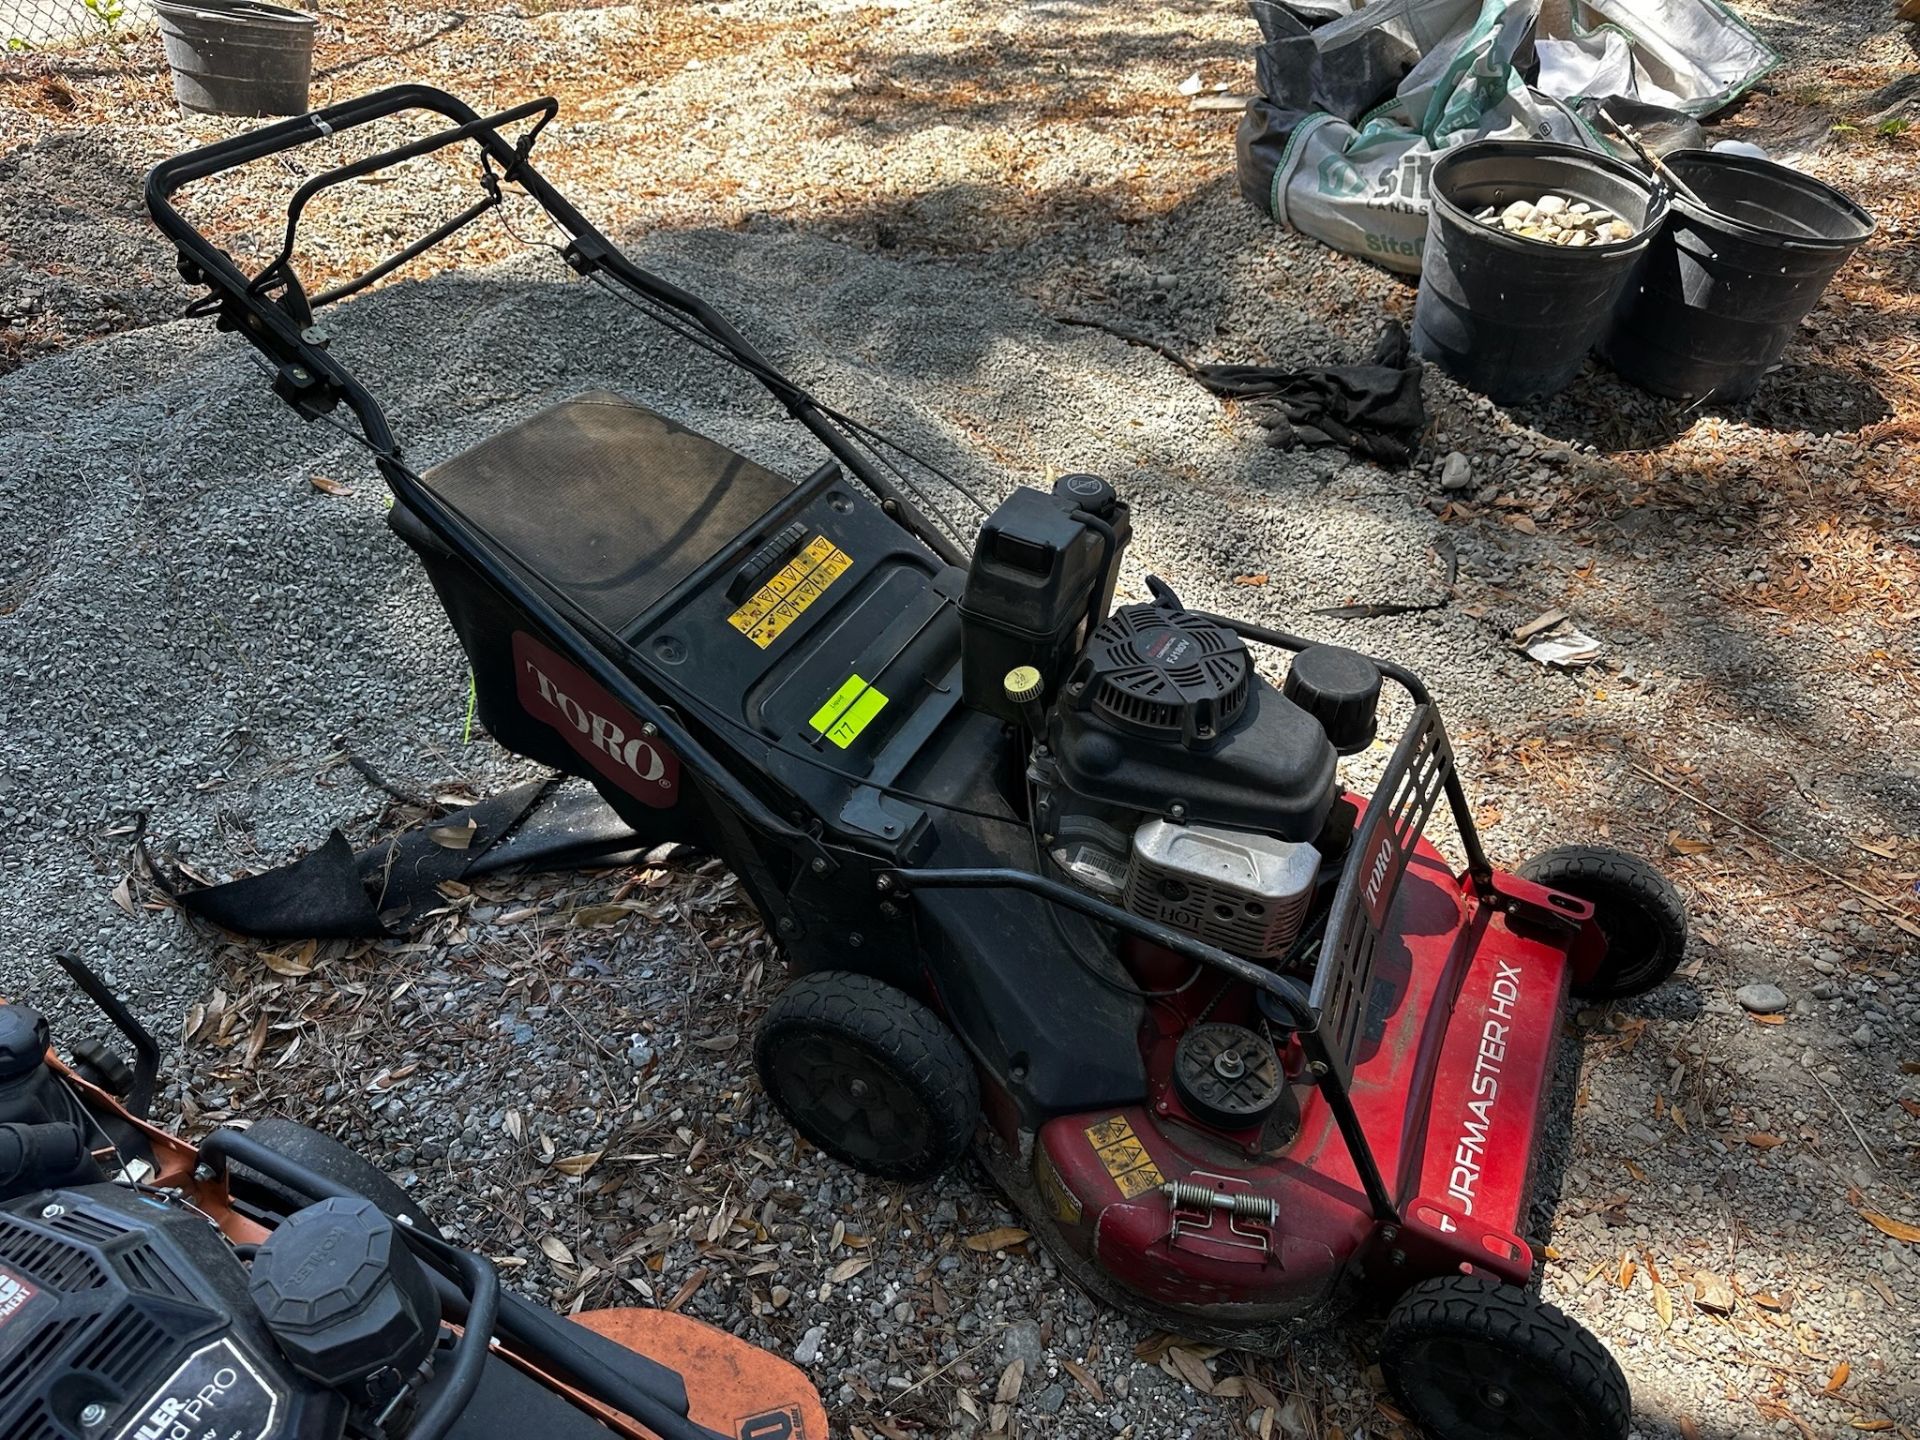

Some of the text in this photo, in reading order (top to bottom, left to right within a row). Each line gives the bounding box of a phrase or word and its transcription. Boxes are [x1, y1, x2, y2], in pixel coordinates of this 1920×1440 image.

[526, 660, 666, 782] TORO
[834, 721, 855, 740] 77
[1366, 838, 1392, 908] TORO
[1160, 905, 1204, 929] HOT
[1488, 959, 1522, 1020] HDX
[184, 1367, 237, 1422] PRO
